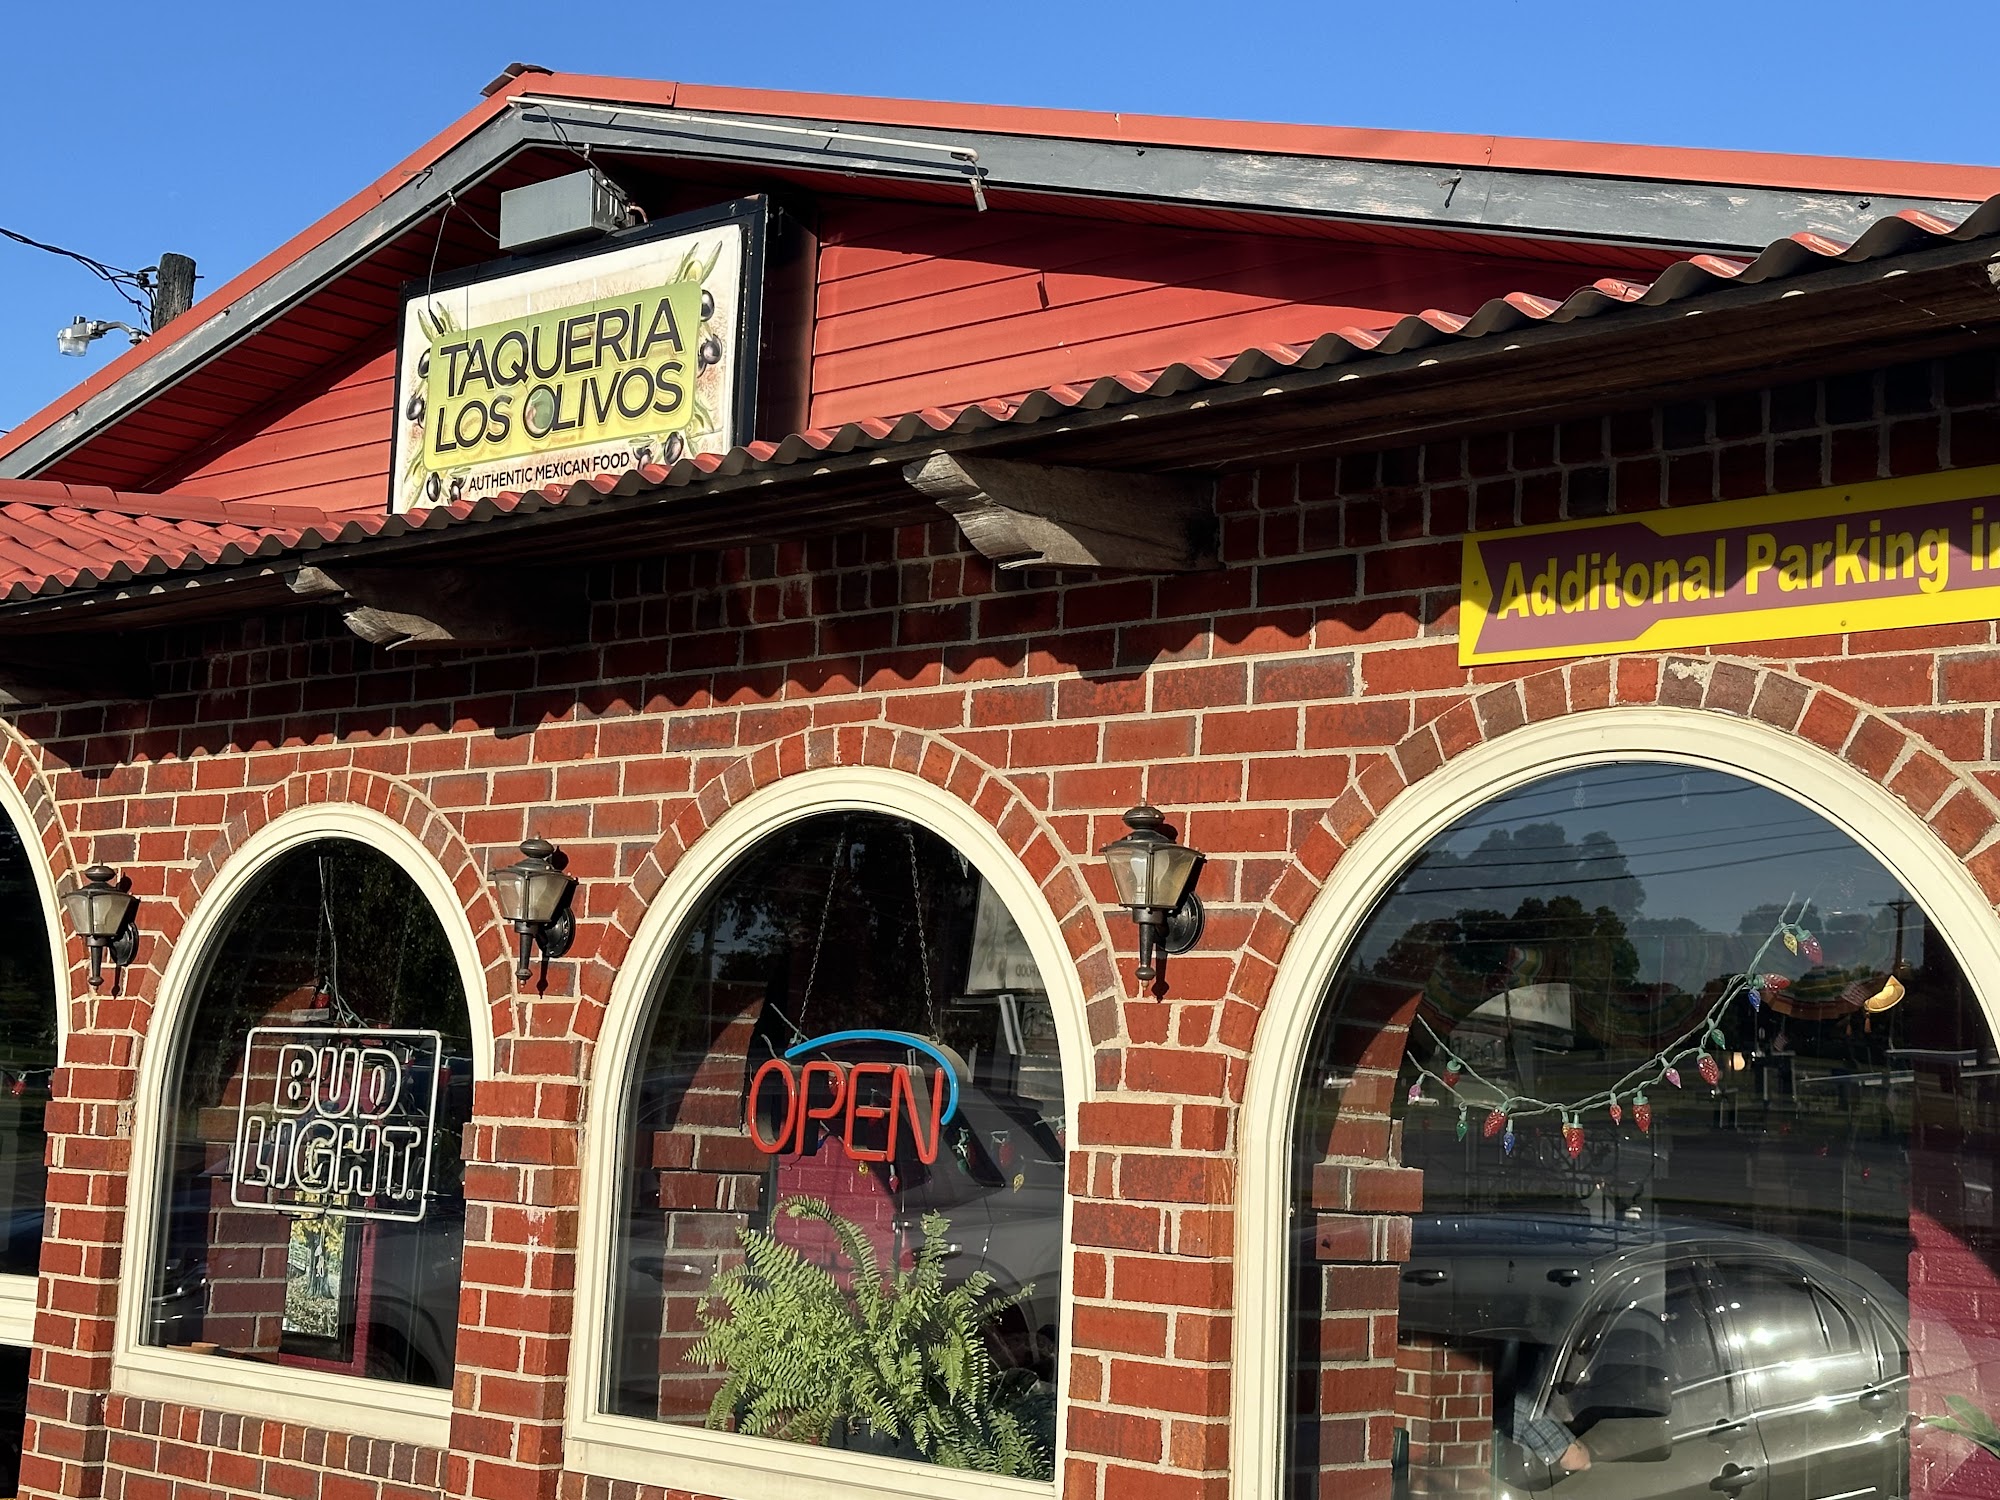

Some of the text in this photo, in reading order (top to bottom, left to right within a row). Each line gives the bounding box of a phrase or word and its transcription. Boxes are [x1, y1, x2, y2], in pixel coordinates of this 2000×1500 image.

[440, 297, 683, 398] TAQUERIA
[434, 361, 683, 453] LOS OLIVOS
[468, 452, 630, 492] AUTHENTIC MEXICAN FOOD
[1496, 538, 1726, 620] Additonal
[1745, 518, 1949, 594] Parking
[273, 1044, 402, 1120] BUD
[750, 1058, 945, 1165] OPEN
